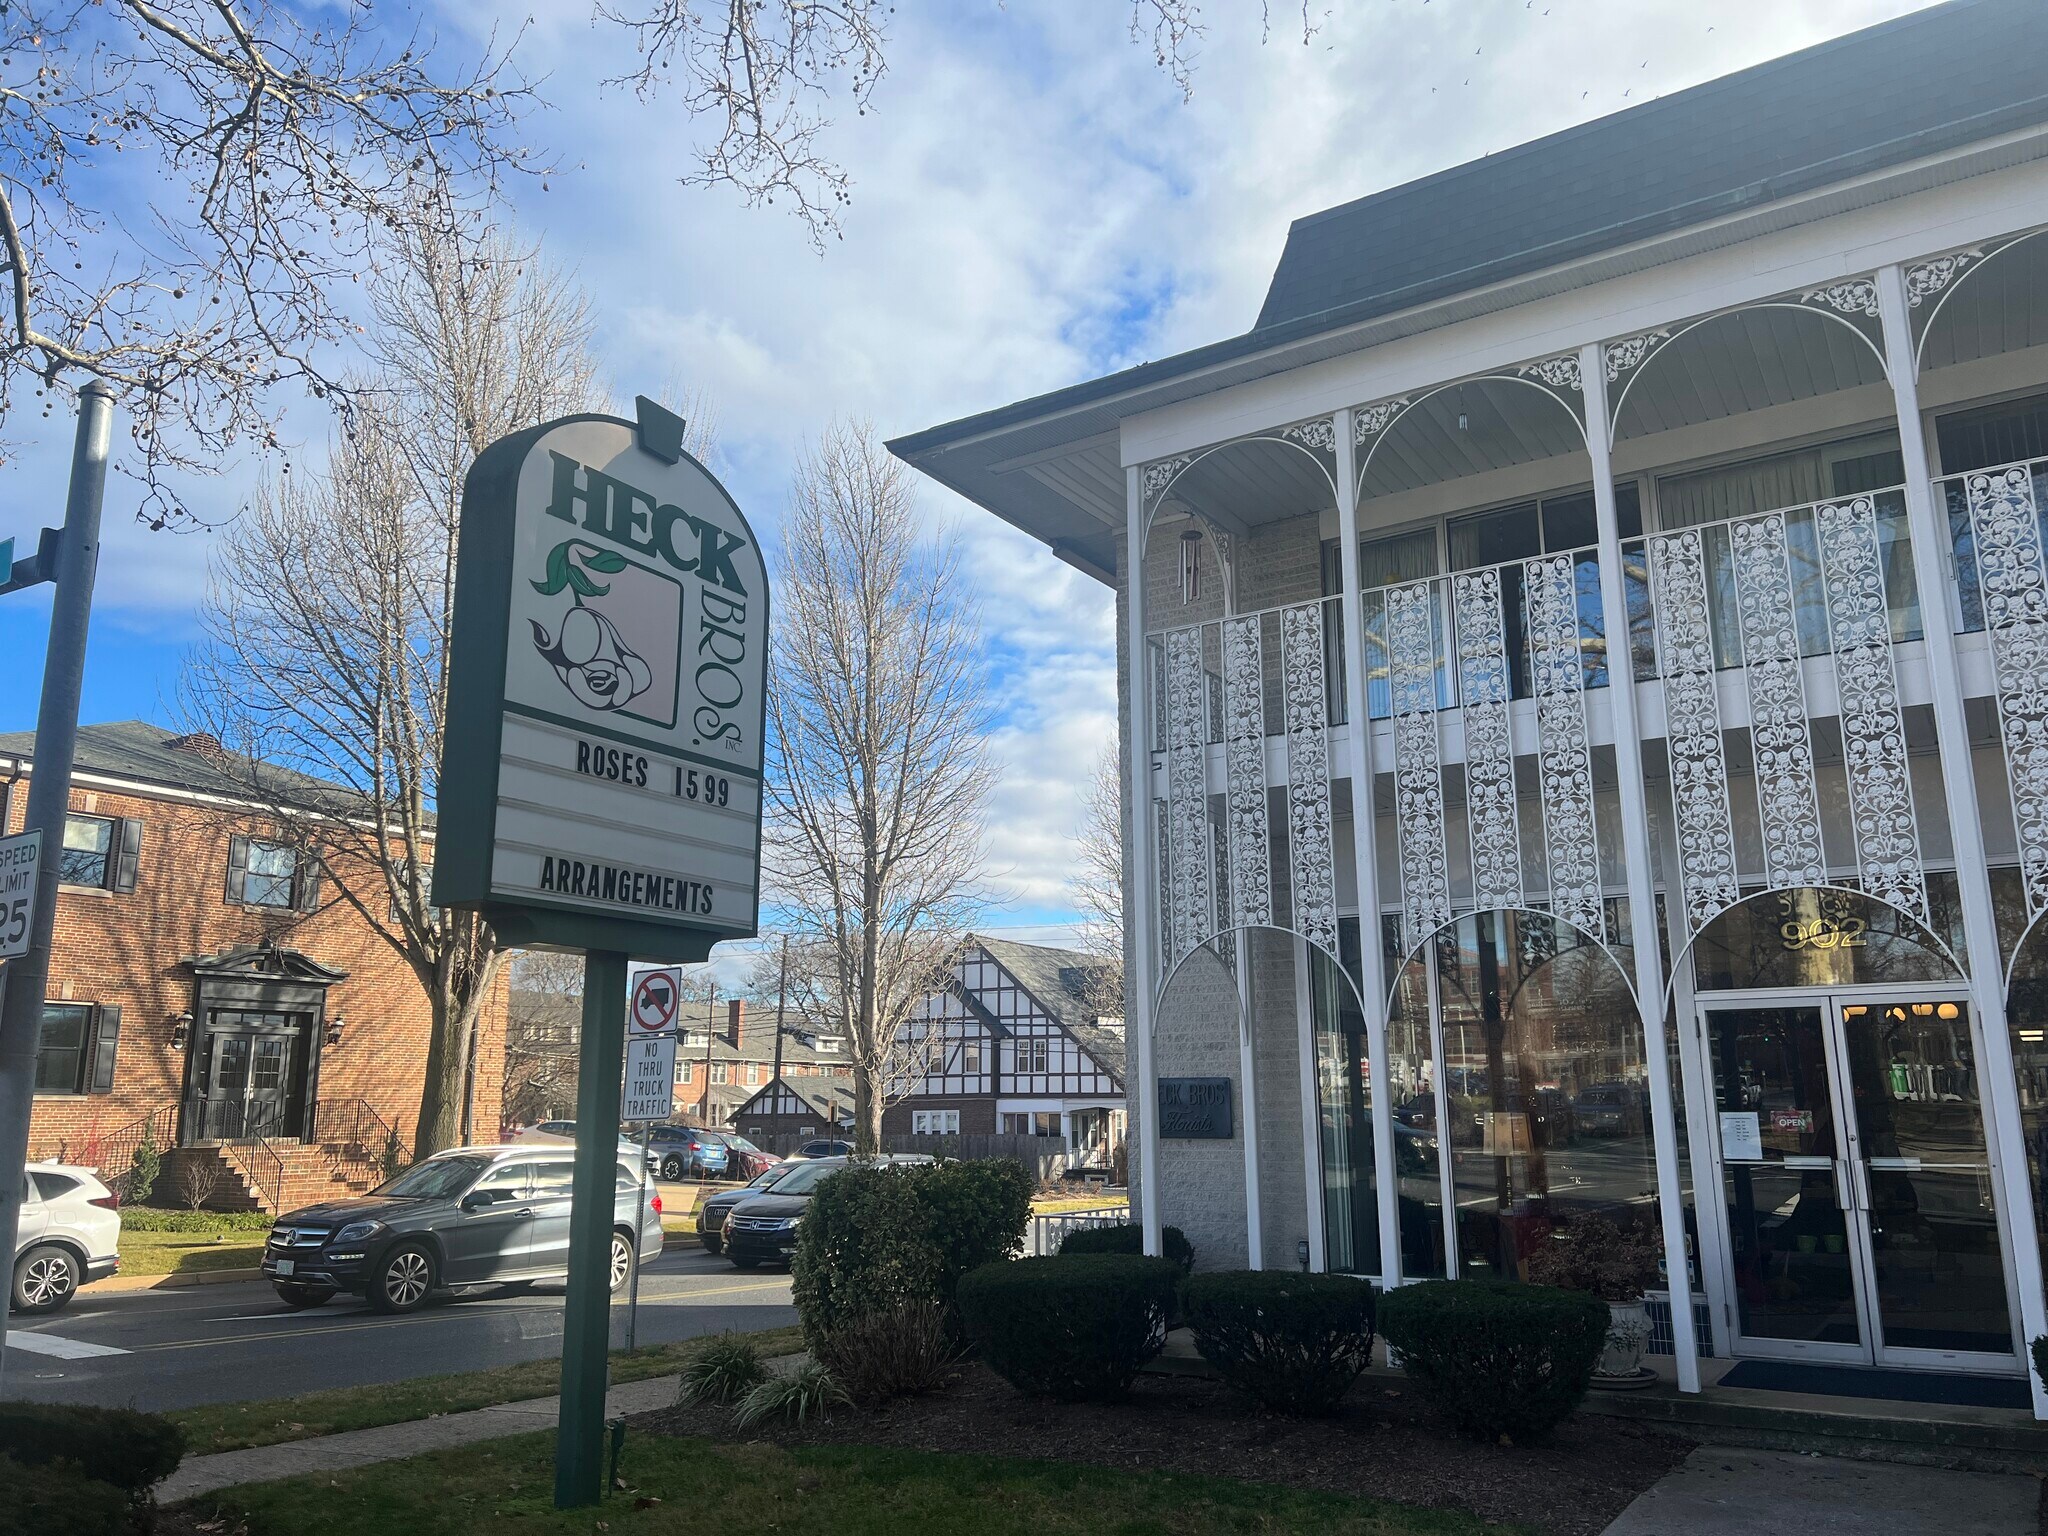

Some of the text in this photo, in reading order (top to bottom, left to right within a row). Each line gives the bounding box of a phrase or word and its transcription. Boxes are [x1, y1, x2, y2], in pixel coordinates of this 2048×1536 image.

[546, 449, 748, 598] HECK
[577, 740, 648, 787] ROSES
[540, 856, 713, 915] ARRANGEMENTS
[1781, 917, 1867, 950] 902
[645, 1042, 658, 1058] NO
[638, 1061, 662, 1077] THRU
[634, 1080, 664, 1096] TRUCK
[1159, 1084, 1225, 1106] ECK BROS
[628, 1099, 667, 1116] TRAFFIC
[1779, 1118, 1805, 1127] OPEN
